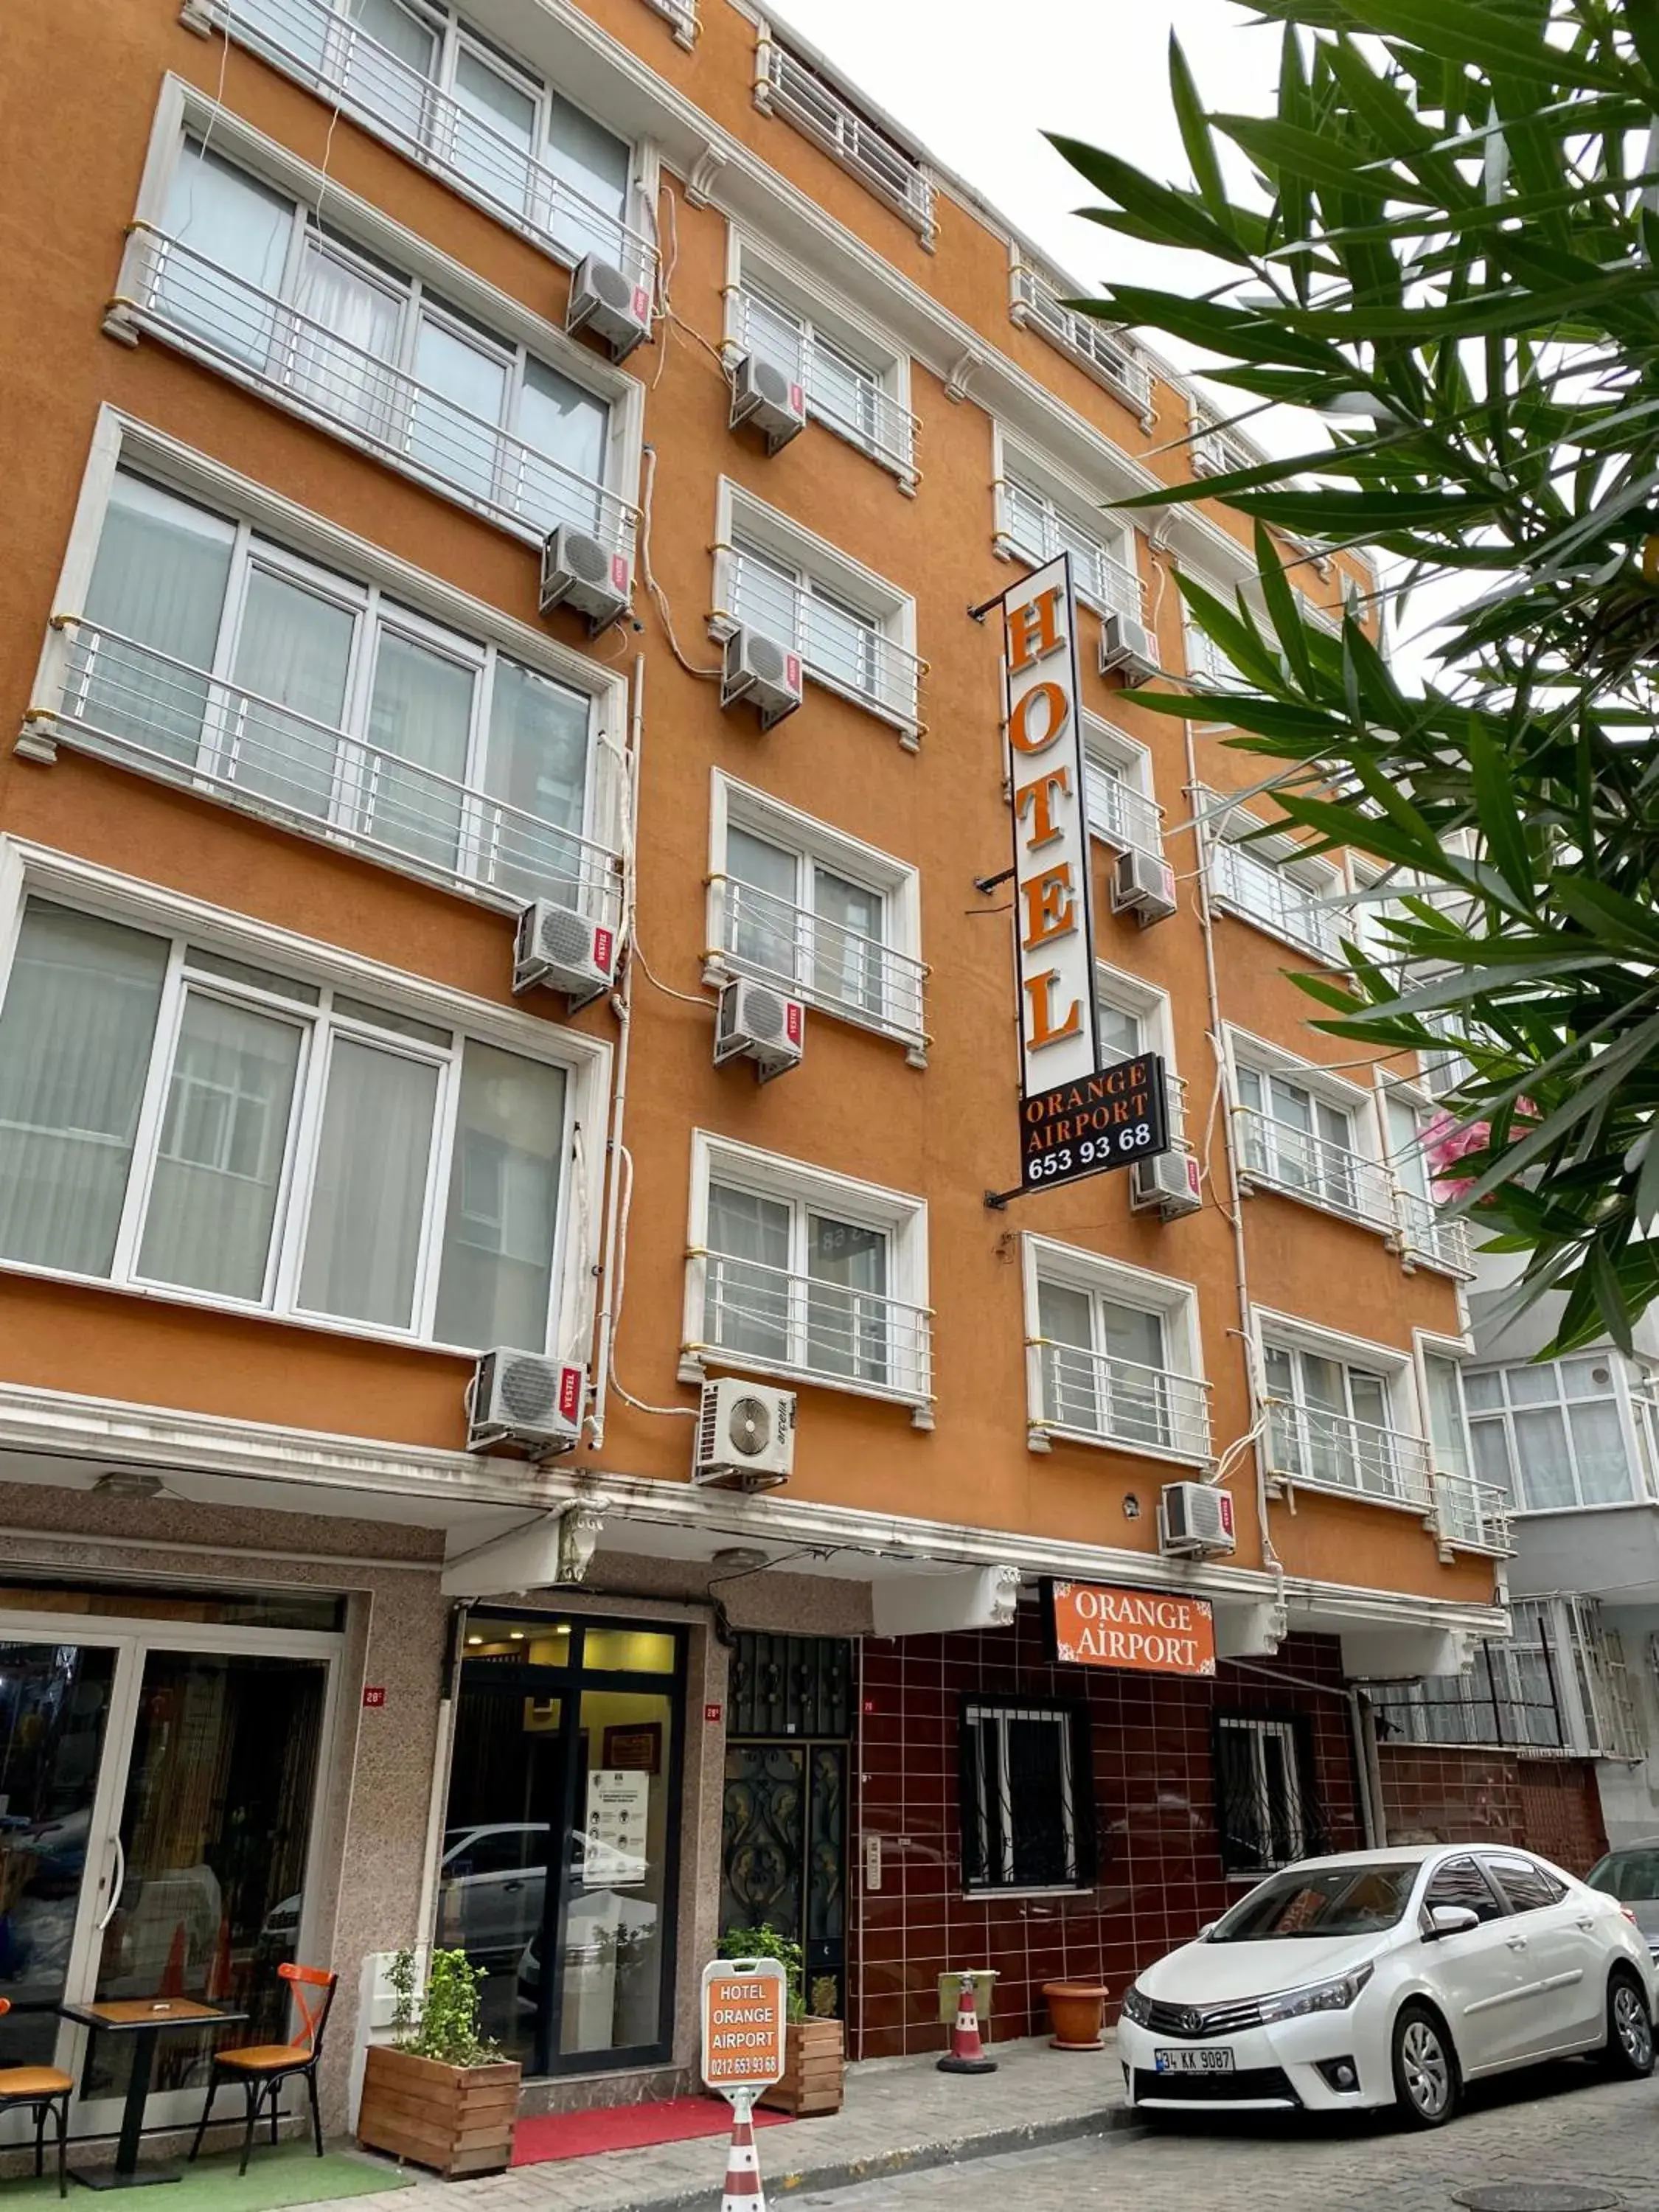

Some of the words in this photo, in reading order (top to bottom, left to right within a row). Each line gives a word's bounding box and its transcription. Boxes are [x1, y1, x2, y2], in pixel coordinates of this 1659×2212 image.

[1006, 585, 1085, 1054] HOTEL
[597, 933, 608, 961] VESTEL
[1026, 1062, 1147, 1123] ORANGE
[1027, 1092, 1148, 1153] AIRPORT
[1029, 1149, 1072, 1180] 653
[1079, 1136, 1110, 1164] 93
[1119, 1123, 1150, 1150] 68
[563, 1374, 574, 1409] VESTEL
[1074, 1590, 1193, 1631] ORANGE
[720, 1983, 767, 2000] HOTEL
[713, 2007, 773, 2025] ORANGE
[712, 2058, 733, 2076] 0212
[734, 2057, 751, 2074] 653
[753, 2056, 763, 2073] 93
[1163, 2052, 1177, 2069] 34
[1180, 2052, 1197, 2069] KK
[1200, 2051, 1229, 2068] 9087
